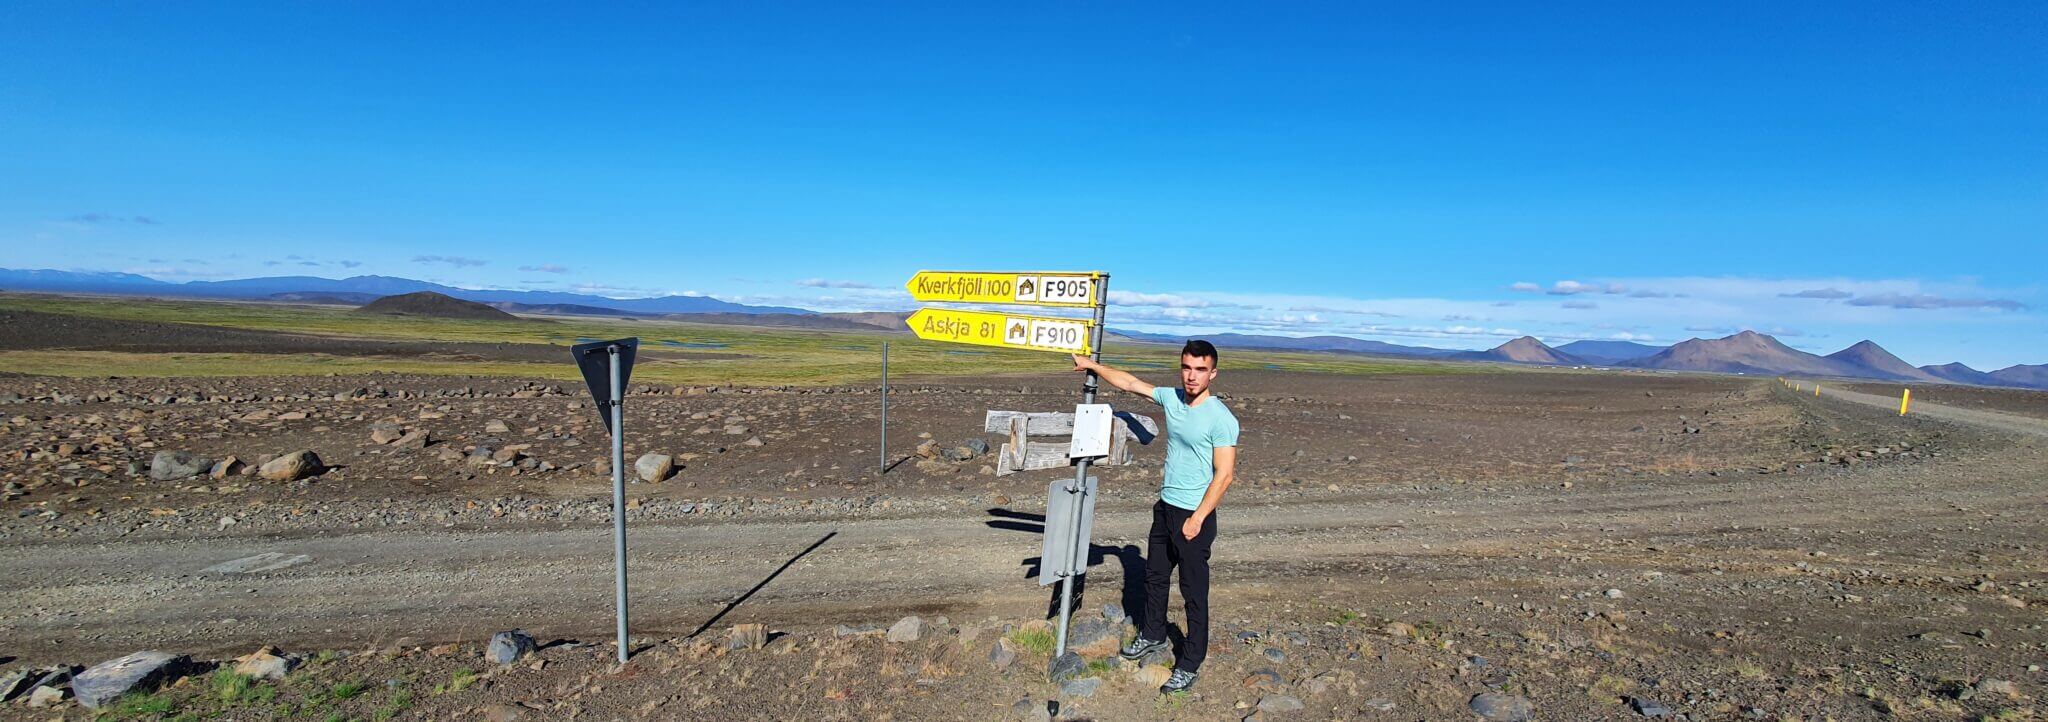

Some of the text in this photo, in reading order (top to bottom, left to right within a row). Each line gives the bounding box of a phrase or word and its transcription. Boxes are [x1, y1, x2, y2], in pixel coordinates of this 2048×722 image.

[917, 276, 1087, 300] Kverkfjöll 100 F905
[923, 316, 1077, 344] Askja 81 F910
